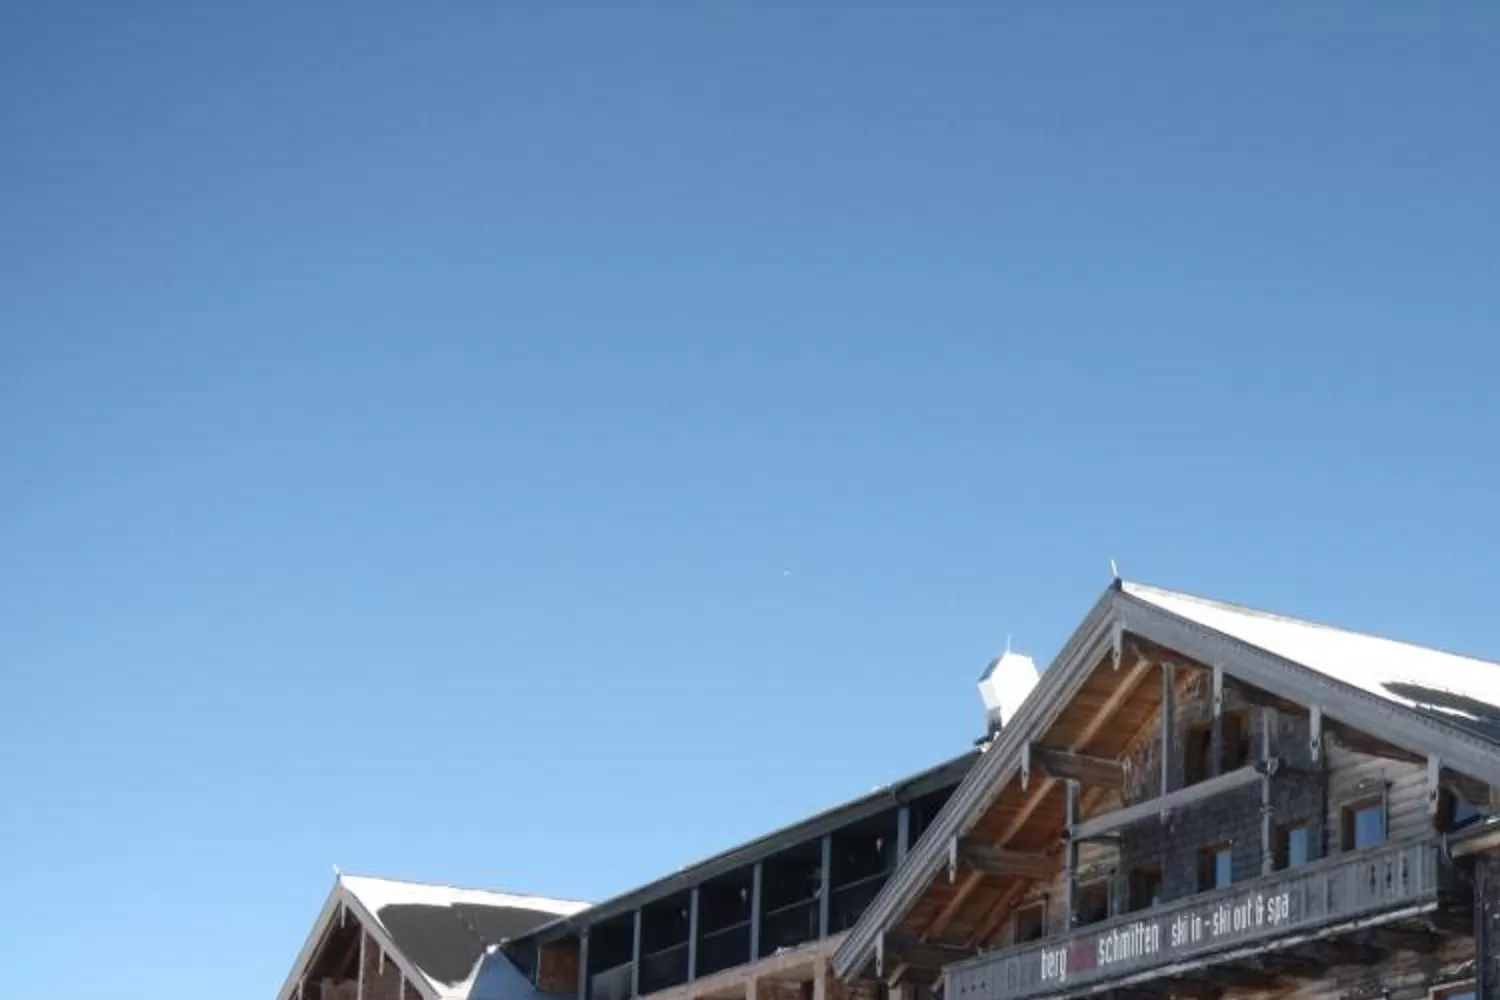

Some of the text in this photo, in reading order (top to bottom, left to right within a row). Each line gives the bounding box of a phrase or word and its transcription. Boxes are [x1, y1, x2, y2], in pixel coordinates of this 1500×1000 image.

[1098, 921, 1158, 966] schmitten
[1171, 914, 1189, 947] ski
[1191, 912, 1201, 944] in
[1212, 903, 1231, 936] ski
[1233, 898, 1252, 930] out
[1255, 895, 1264, 925] &
[1267, 893, 1288, 925] spa
